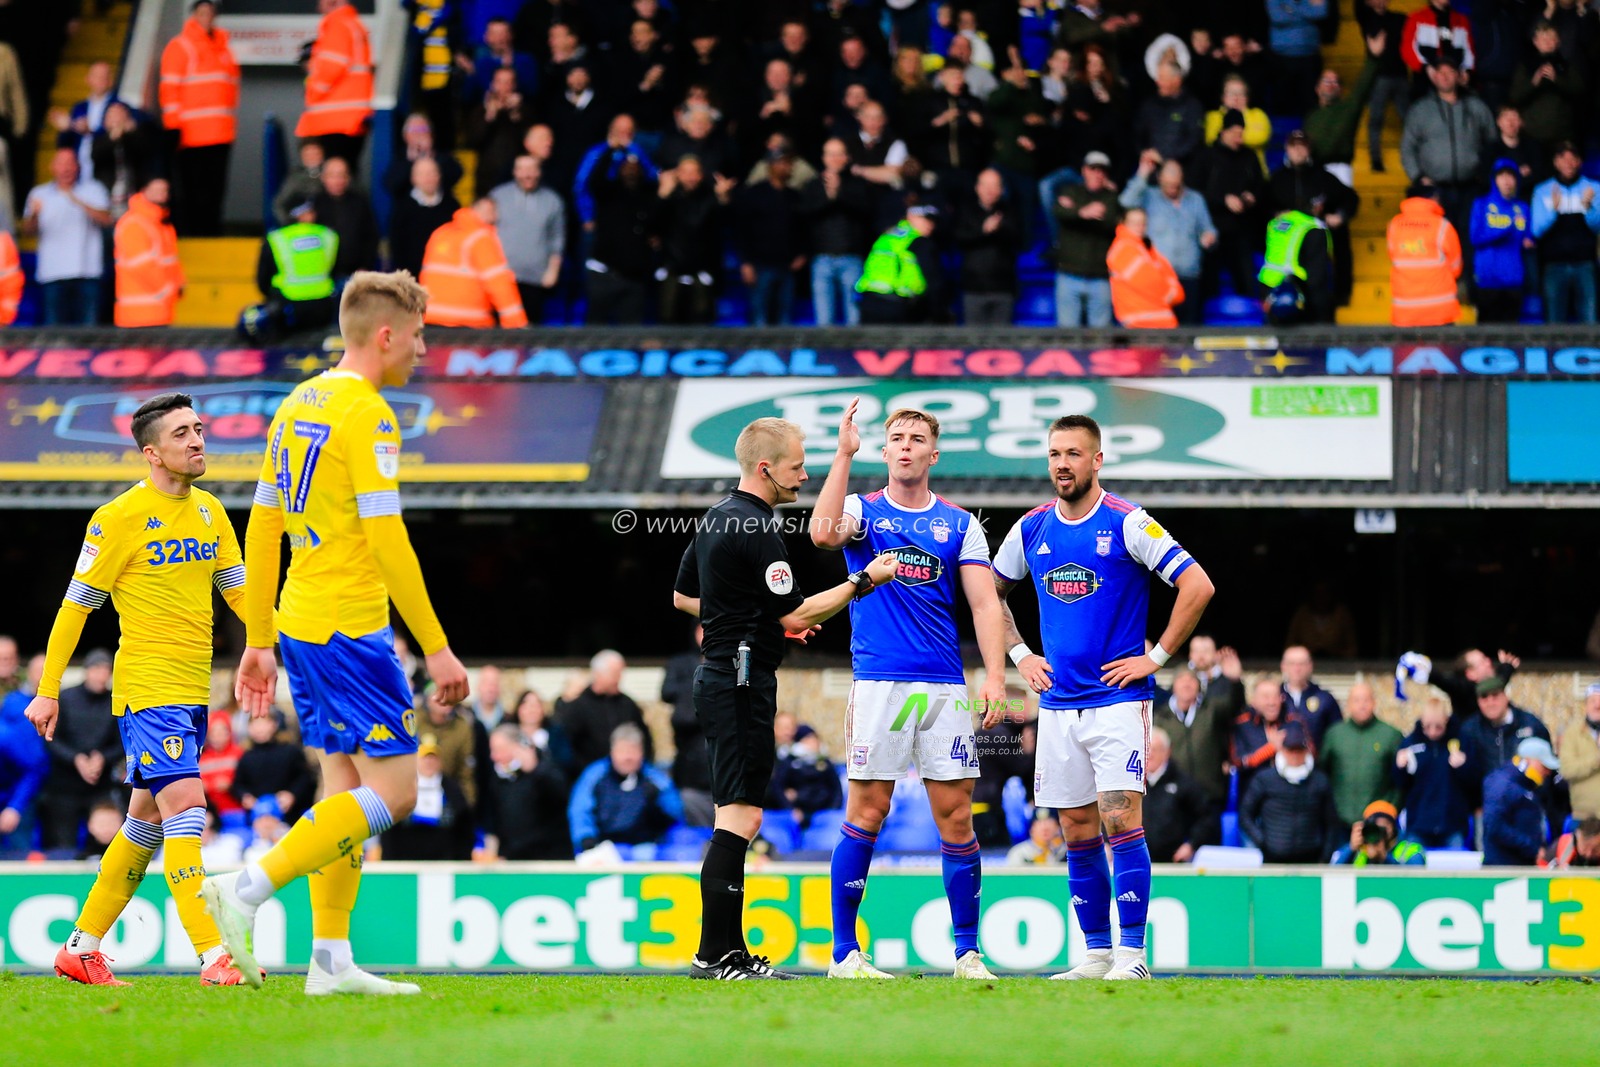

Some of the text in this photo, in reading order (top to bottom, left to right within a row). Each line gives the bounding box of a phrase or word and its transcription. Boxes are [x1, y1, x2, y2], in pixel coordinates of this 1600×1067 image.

[0, 349, 266, 378] VEGAS
[446, 349, 1142, 377] MAGICAL VEGAS
[1326, 346, 1600, 375] MAGIC
[272, 419, 331, 514] 47
[146, 537, 220, 567] 32Red
[896, 563, 931, 580] EGAS
[1053, 571, 1087, 581] MAGICAL
[1053, 581, 1088, 595] VEGAS
[1126, 750, 1143, 781] 4
[1321, 873, 1600, 972] bet3
